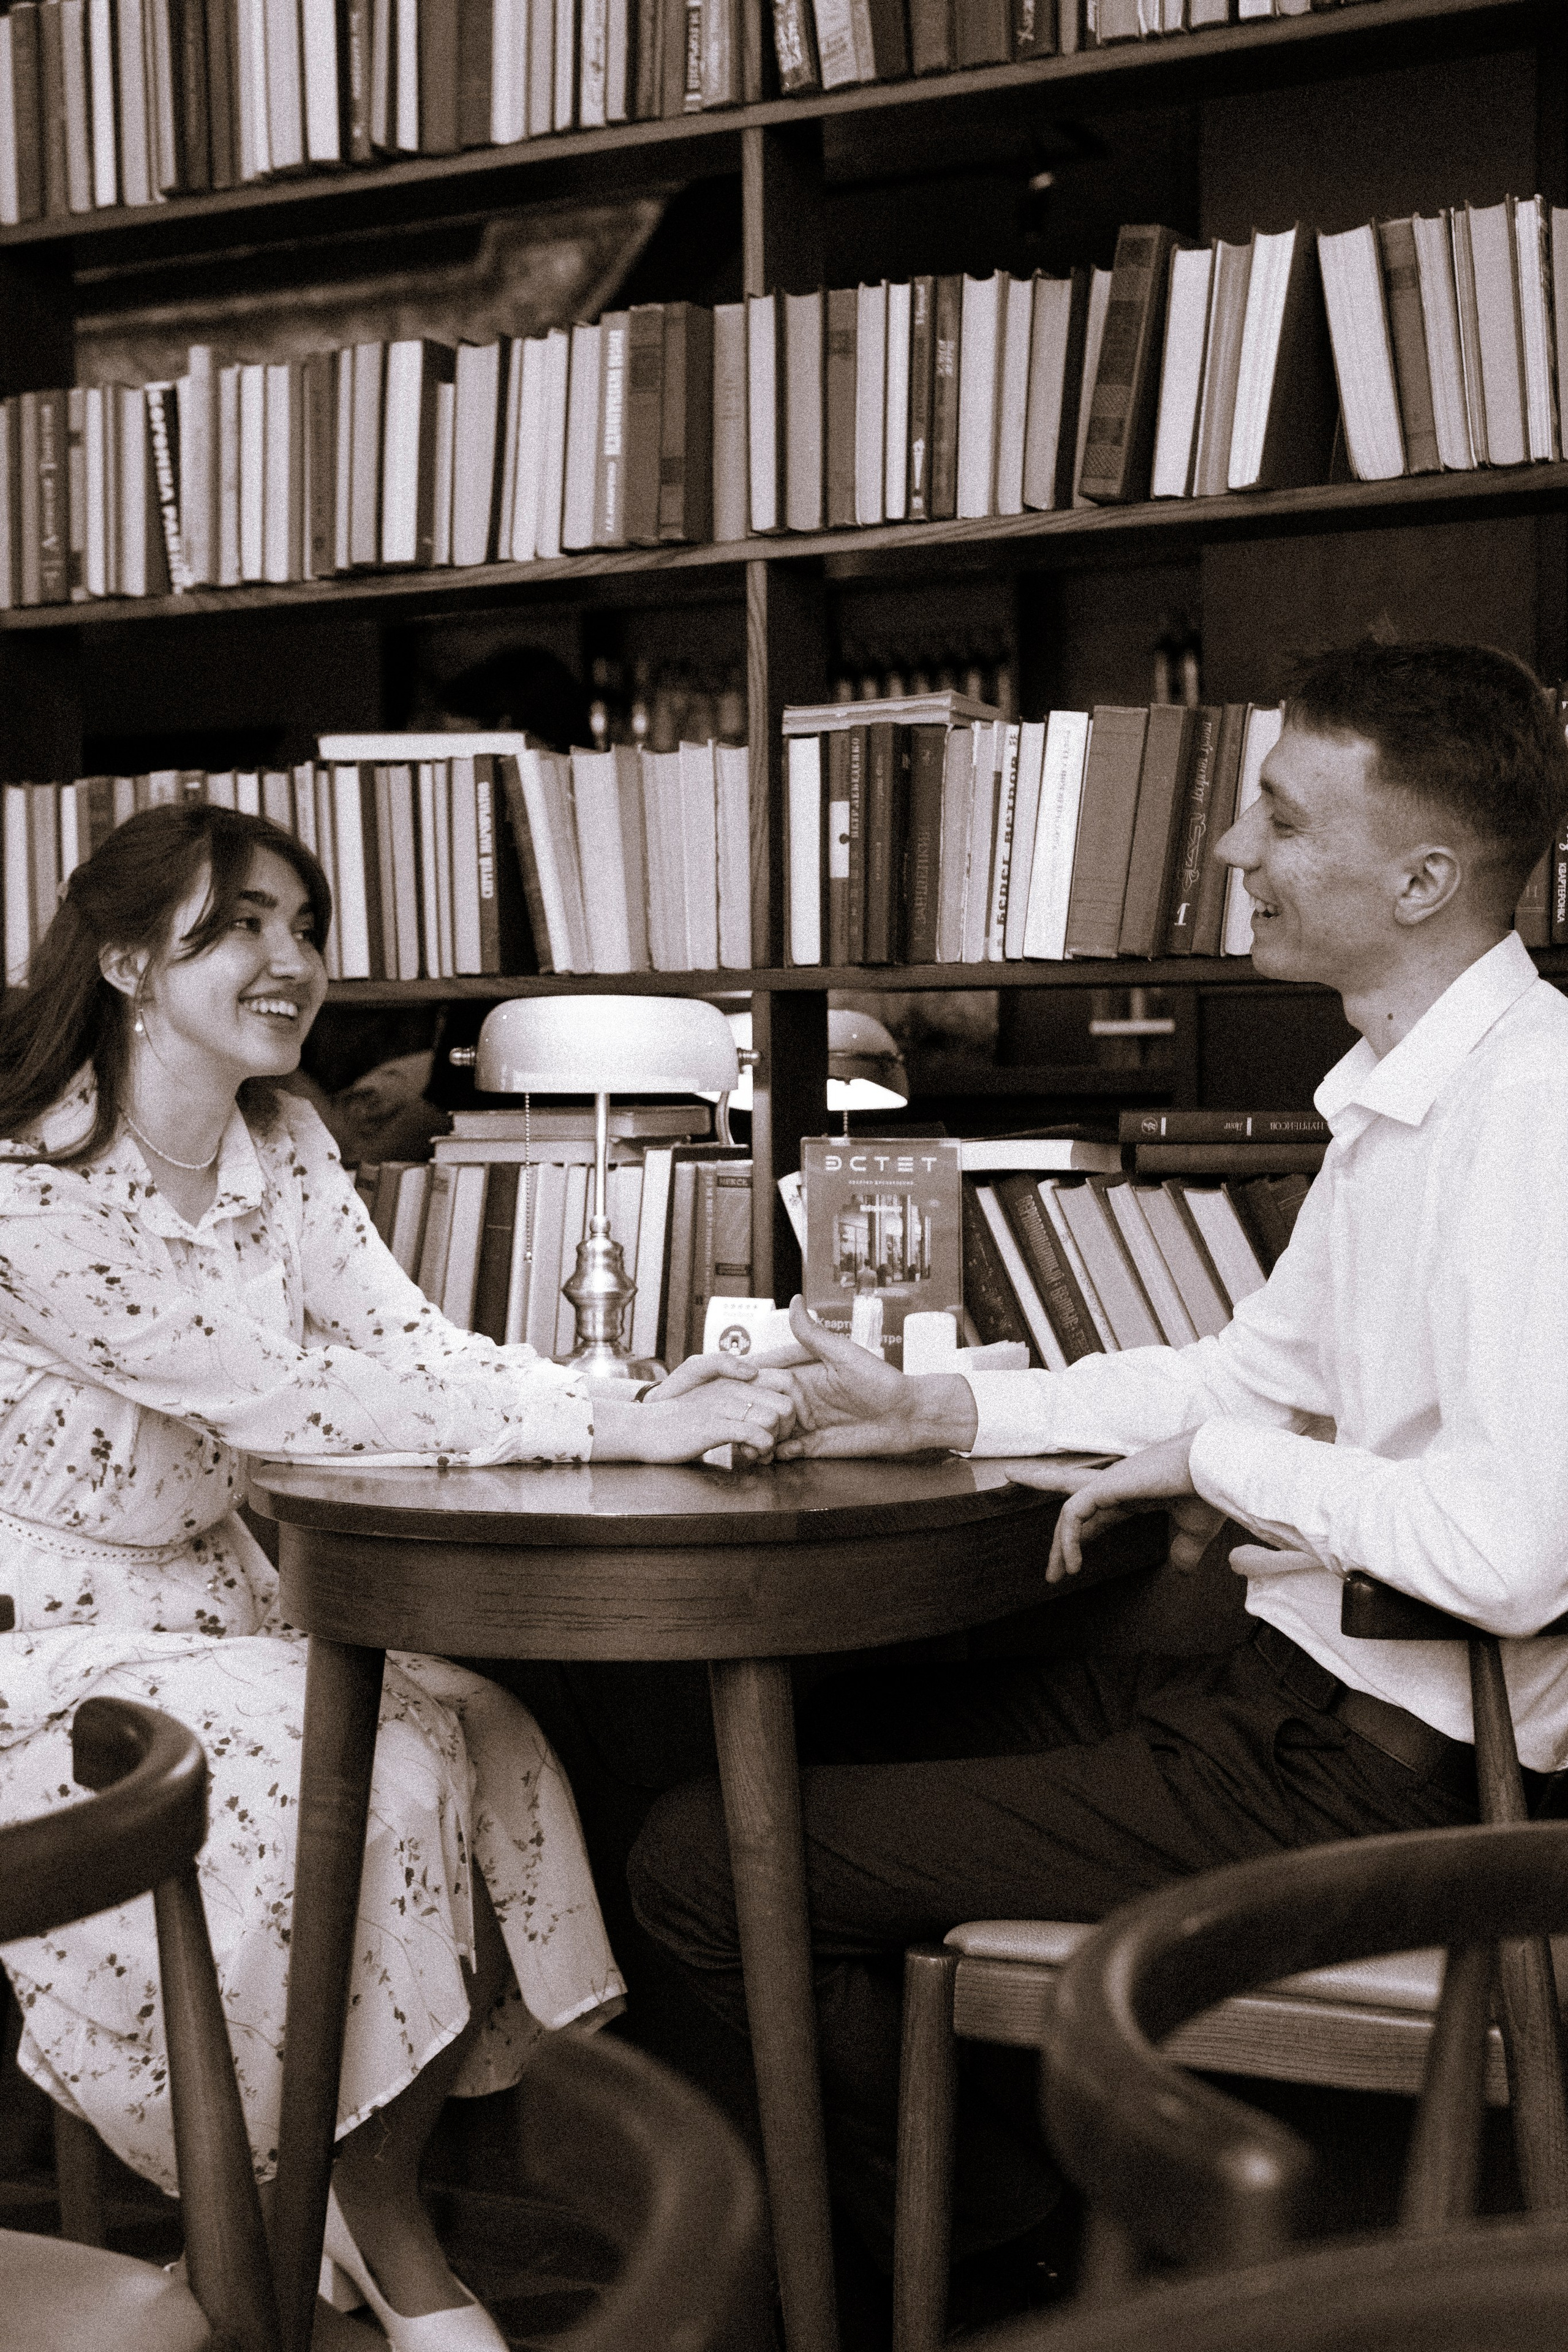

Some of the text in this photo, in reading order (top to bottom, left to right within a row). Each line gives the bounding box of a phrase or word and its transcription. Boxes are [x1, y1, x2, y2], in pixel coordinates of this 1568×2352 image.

[479, 858, 493, 899] СЕРГЕЙ
[1557, 862, 1567, 922] КВАРТЕРОНКА
[1174, 902, 1190, 925] 1
[825, 1155, 937, 1172] ЭСТЕТ
